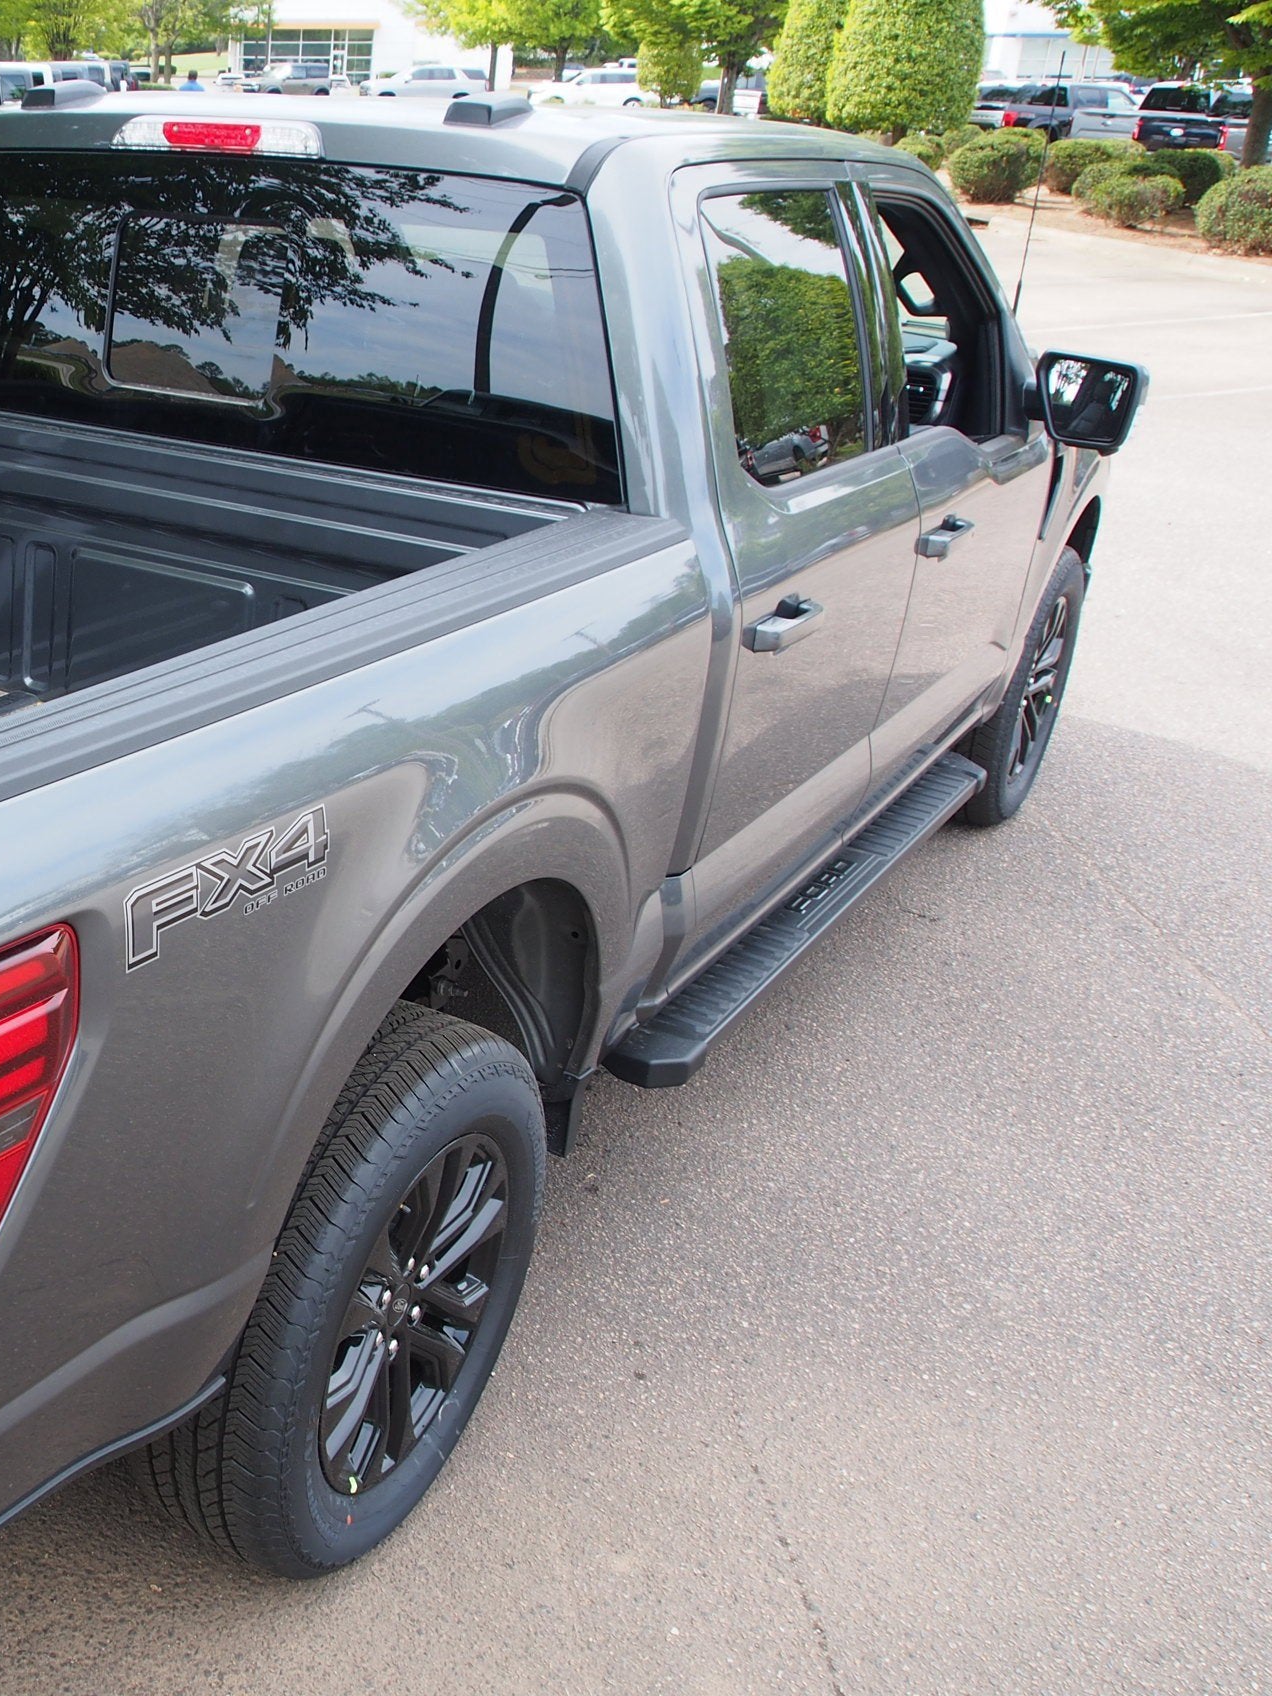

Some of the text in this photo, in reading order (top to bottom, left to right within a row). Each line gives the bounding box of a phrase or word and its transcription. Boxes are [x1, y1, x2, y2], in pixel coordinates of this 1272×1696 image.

[123, 803, 330, 973] FX4
[243, 867, 327, 915] OFF ROAD
[784, 860, 858, 914] FORD
